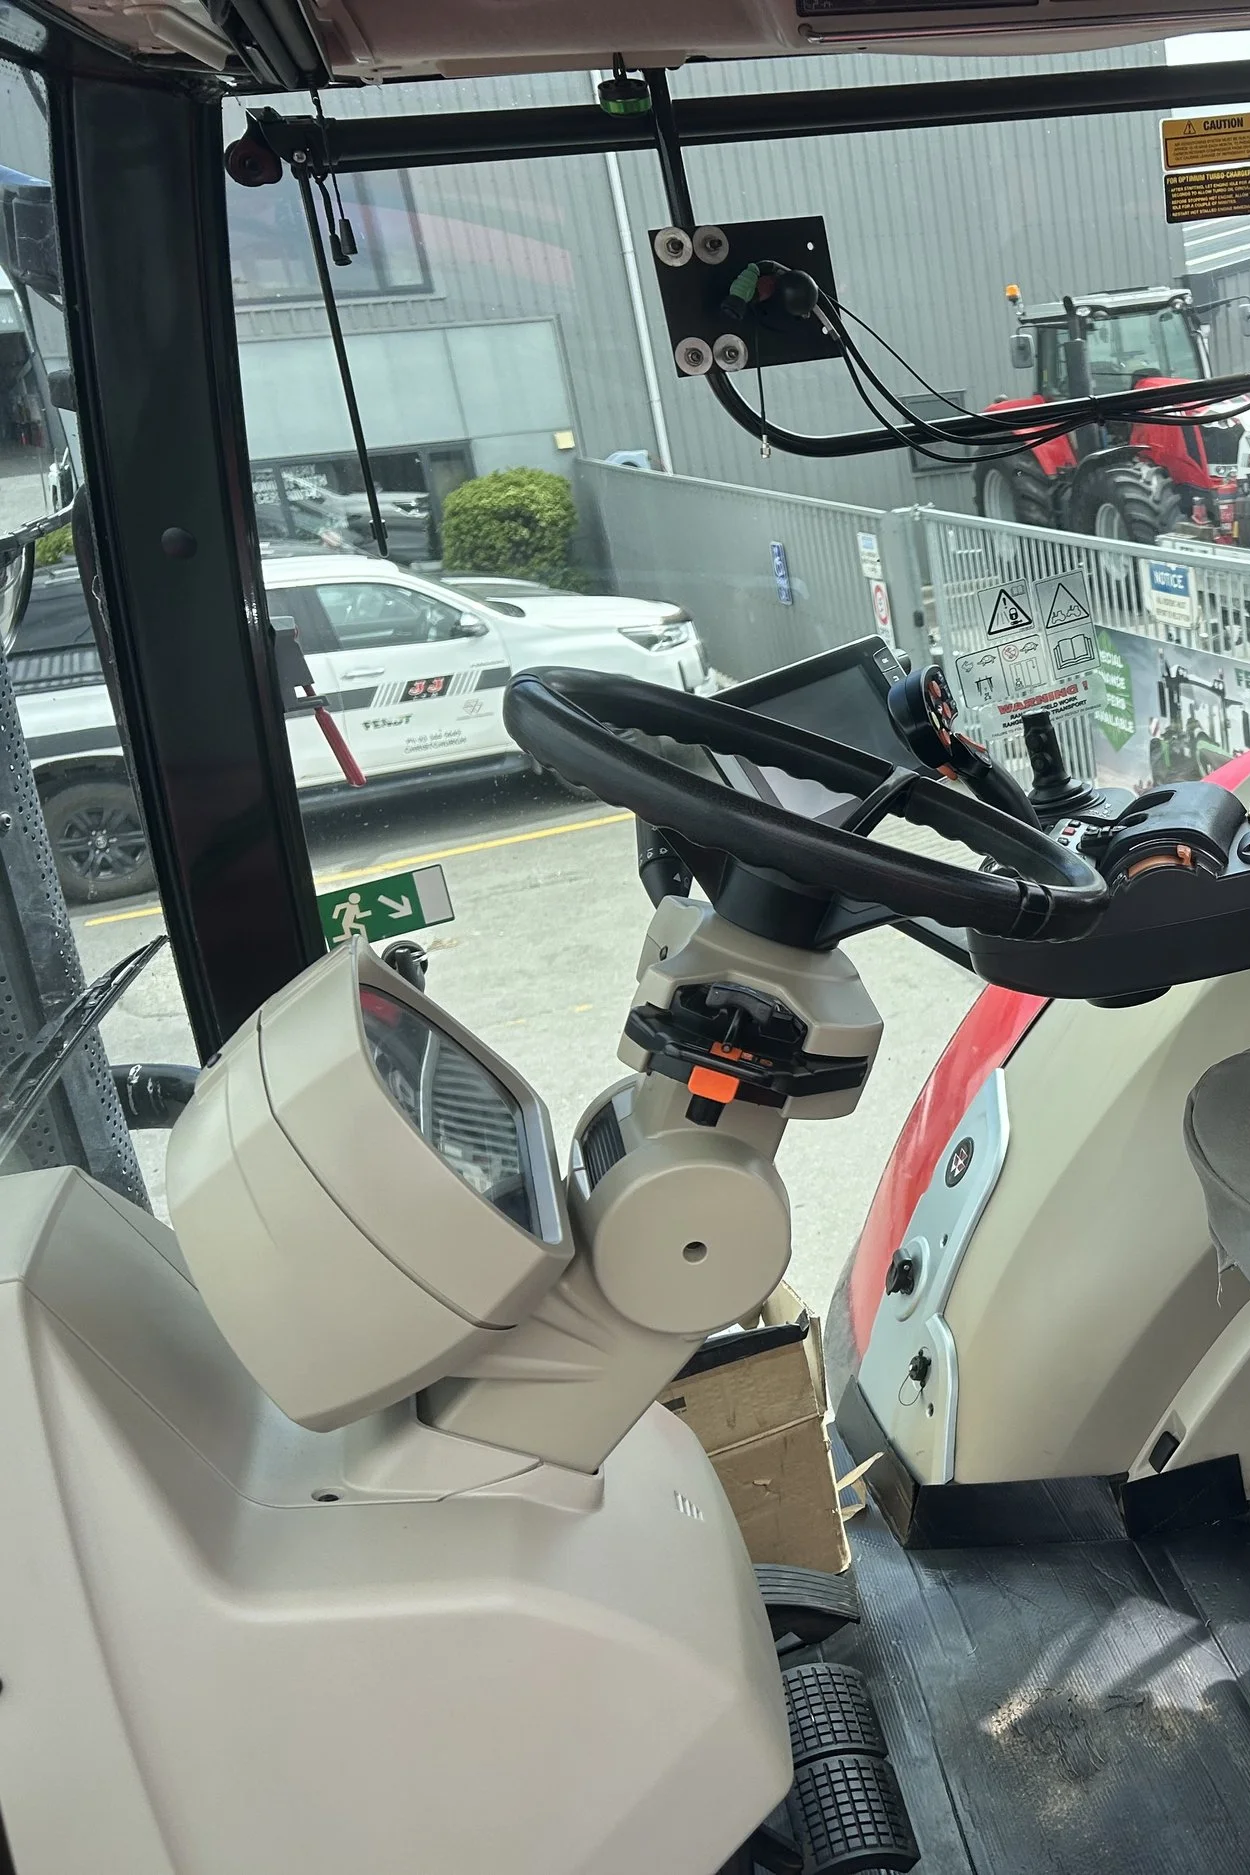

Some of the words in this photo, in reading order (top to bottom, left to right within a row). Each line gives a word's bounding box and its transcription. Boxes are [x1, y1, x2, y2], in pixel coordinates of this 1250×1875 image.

[1203, 117, 1243, 131] CAUTION
[1153, 570, 1184, 589] NOTICE
[998, 684, 1078, 715] WARNING
[1051, 700, 1087, 715] TRANSPORT
[1059, 695, 1078, 706] WORK
[362, 713, 413, 731] FENDT
